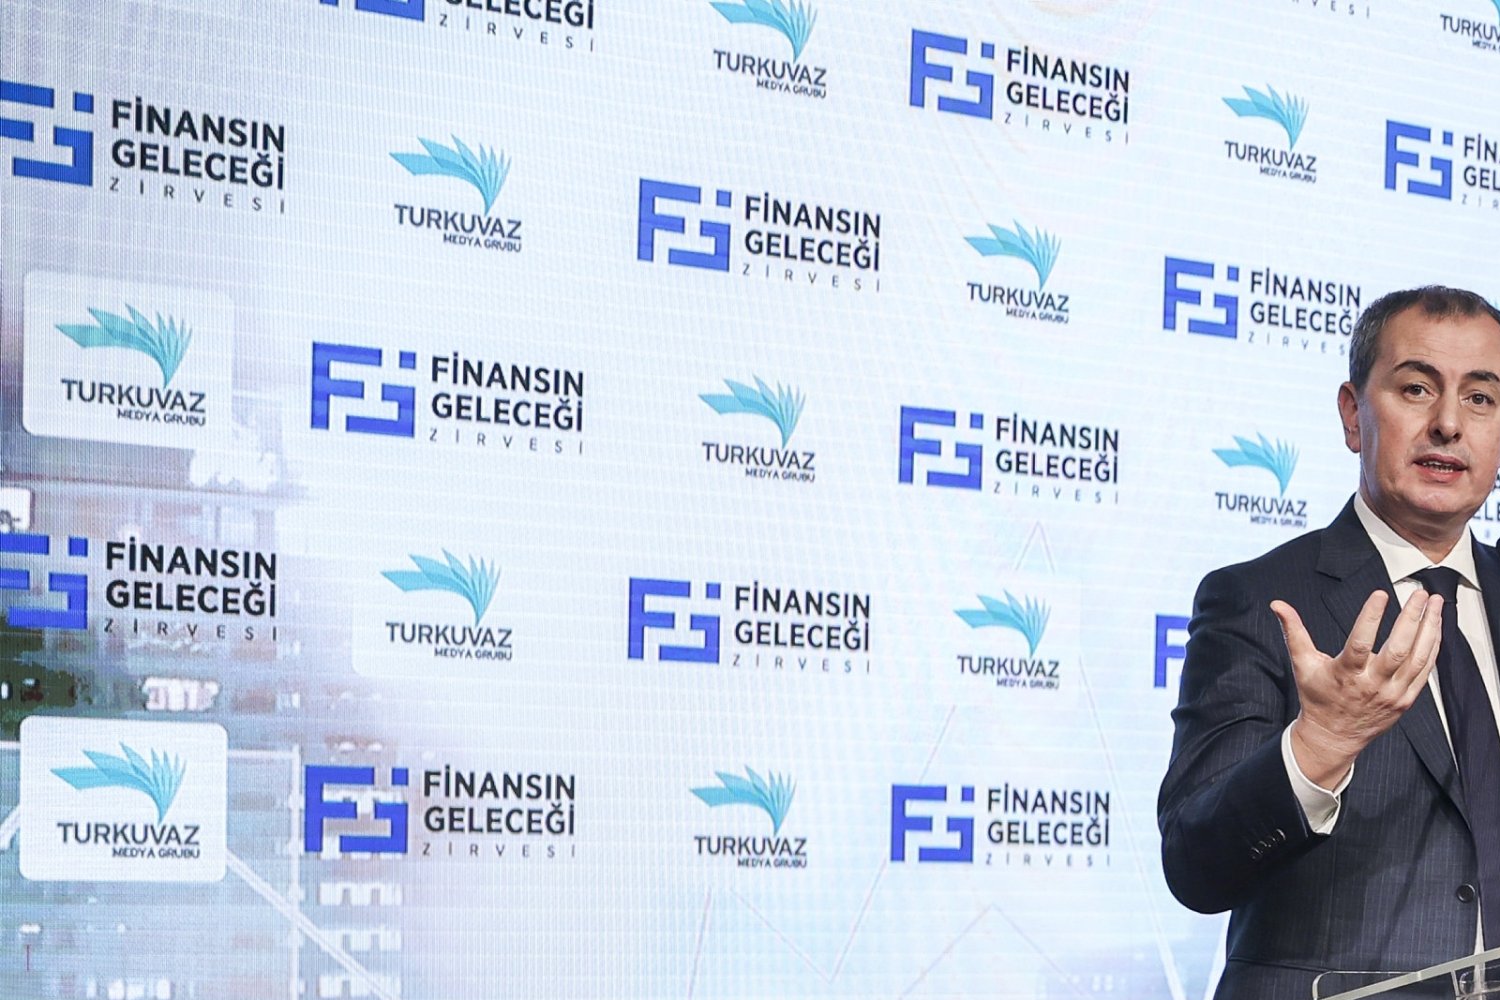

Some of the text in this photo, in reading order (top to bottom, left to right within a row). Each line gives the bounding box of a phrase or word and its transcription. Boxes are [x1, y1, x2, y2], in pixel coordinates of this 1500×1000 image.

[713, 49, 826, 87] TURKUVAZ
[1006, 45, 1129, 94] FİNANSIN
[1006, 82, 1128, 124] GELECEĞİ
[112, 97, 285, 152] FİNANSIN
[112, 139, 284, 189] GELECEĞİ
[1224, 140, 1316, 172] TURKUVAZ
[394, 204, 522, 240] TURKUVAZ
[745, 192, 880, 238] FİNANSIN
[744, 230, 880, 270] GELECEĞİ
[967, 282, 1069, 313] TURKUVAZ
[1250, 268, 1360, 308] FİNANSIN
[432, 352, 584, 398] FİNANSIN
[61, 378, 206, 413] TURKUVAZ
[432, 392, 583, 432] GELECEĞİ
[996, 413, 1118, 452] FİNANSIN
[702, 442, 816, 471] TURKUVAZ
[996, 450, 1118, 484] GELECEĞİ
[1215, 492, 1307, 518] TURKUVAZ
[105, 536, 276, 580] FİNANSIN
[105, 580, 276, 618] GELECEĞİ
[734, 581, 870, 619] FİNANSIN
[385, 622, 512, 648] TURKUVAZ
[734, 620, 870, 652] GELECEĞİ
[957, 656, 1060, 678] TURKUVAZ
[423, 764, 576, 800] FİNANSIN
[988, 782, 1110, 816] FİNANSIN
[56, 822, 200, 845] TURKUVAZ
[424, 803, 575, 836] GELECEĞİ
[988, 817, 1110, 846] GELECEĞİ
[694, 836, 807, 857] TURKUVAZ
